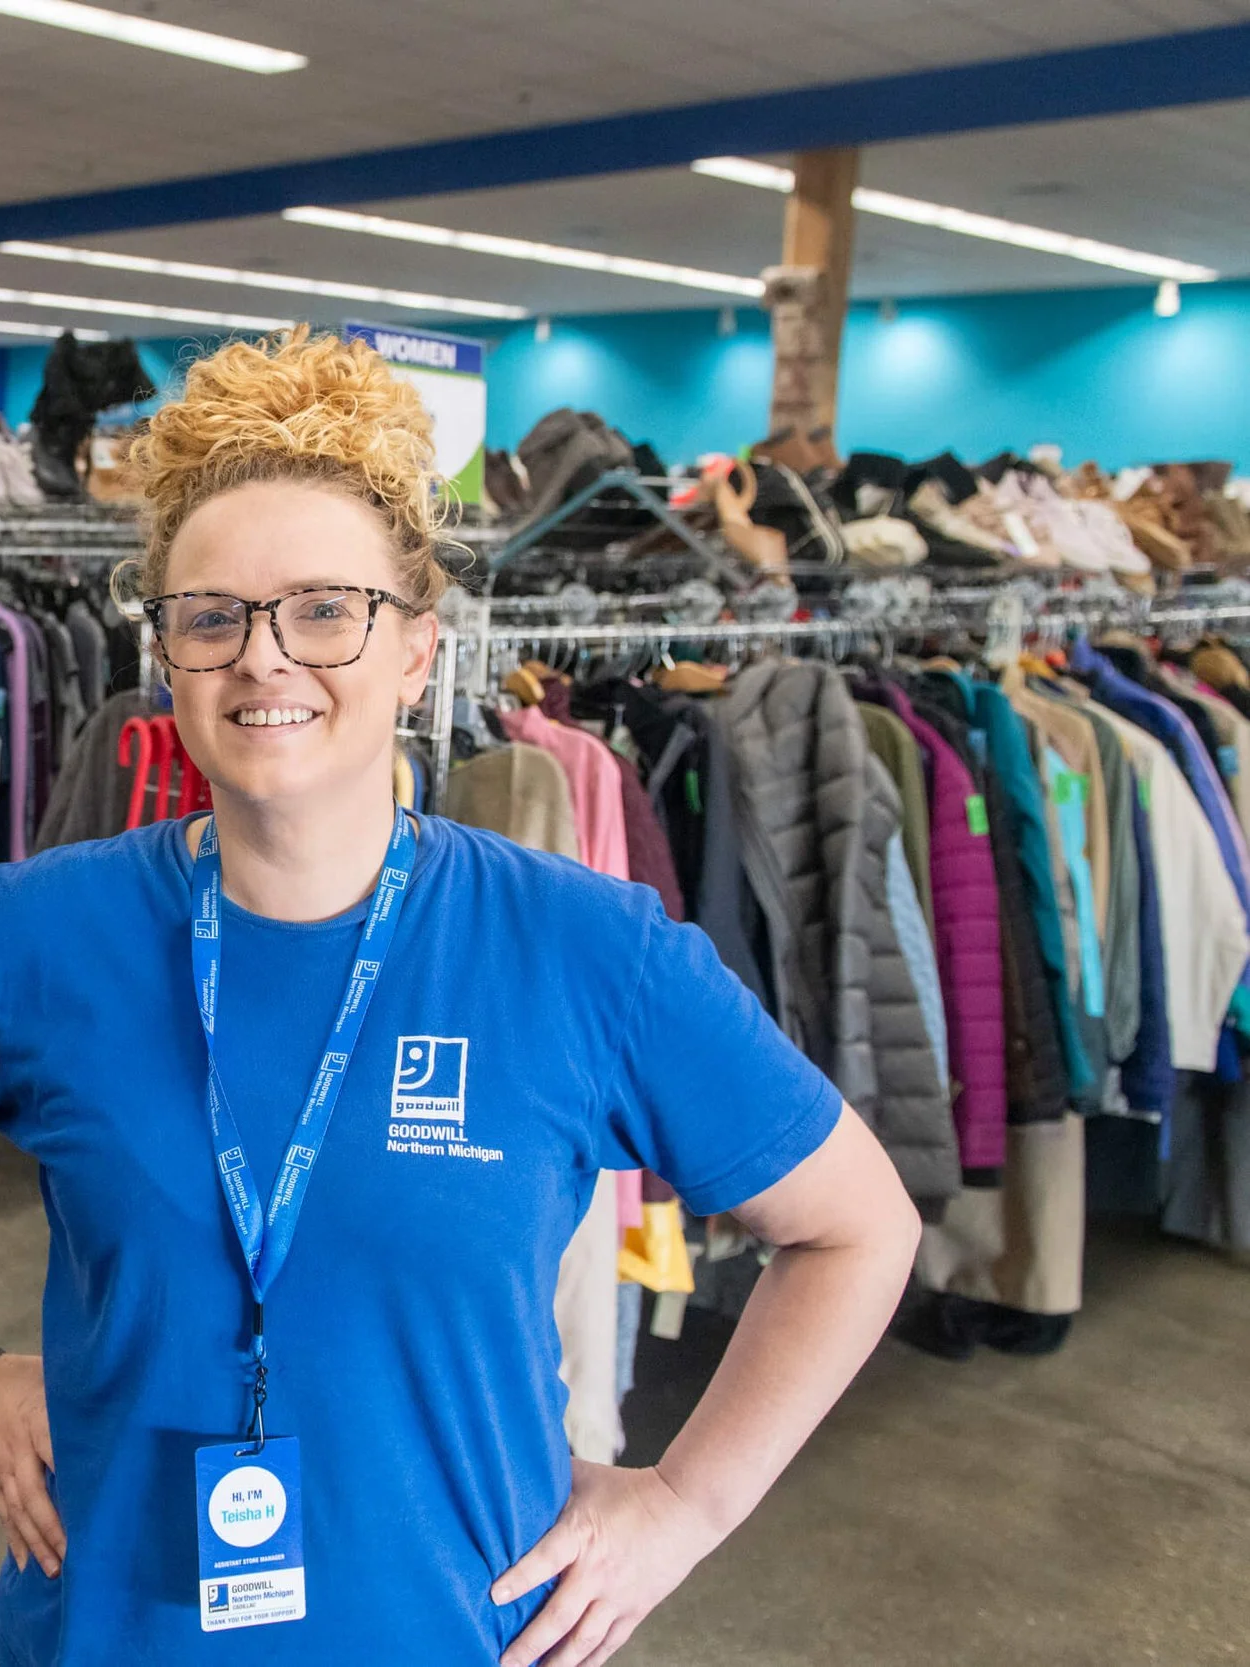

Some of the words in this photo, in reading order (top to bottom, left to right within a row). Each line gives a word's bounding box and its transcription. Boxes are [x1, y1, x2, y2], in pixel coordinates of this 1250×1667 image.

[374, 332, 457, 368] WOMEN
[202, 888, 210, 918] GOODWILL
[379, 888, 395, 922] GOODWILL
[349, 980, 366, 1014] GOODWILL
[315, 1072, 333, 1107] GOODWILL
[396, 1101, 459, 1113] goodwill
[388, 1124, 468, 1142] GOODWILL
[387, 1139, 445, 1156] Northern
[448, 1144, 503, 1162] Michigan
[232, 1171, 250, 1210] GOODWILL
[282, 1168, 300, 1206] GOODWILL
[234, 1203, 248, 1235] Michigan
[232, 1492, 245, 1504] HI,
[247, 1489, 262, 1501] I'M
[221, 1507, 262, 1524] Teisha
[265, 1504, 275, 1519] H
[243, 1556, 260, 1565] STORE
[231, 1580, 274, 1594] GOODWILL
[231, 1594, 262, 1604] Northern
[263, 1589, 294, 1600] Michigan
[241, 1614, 252, 1622] FOR
[271, 1609, 297, 1618] SUPPORT
